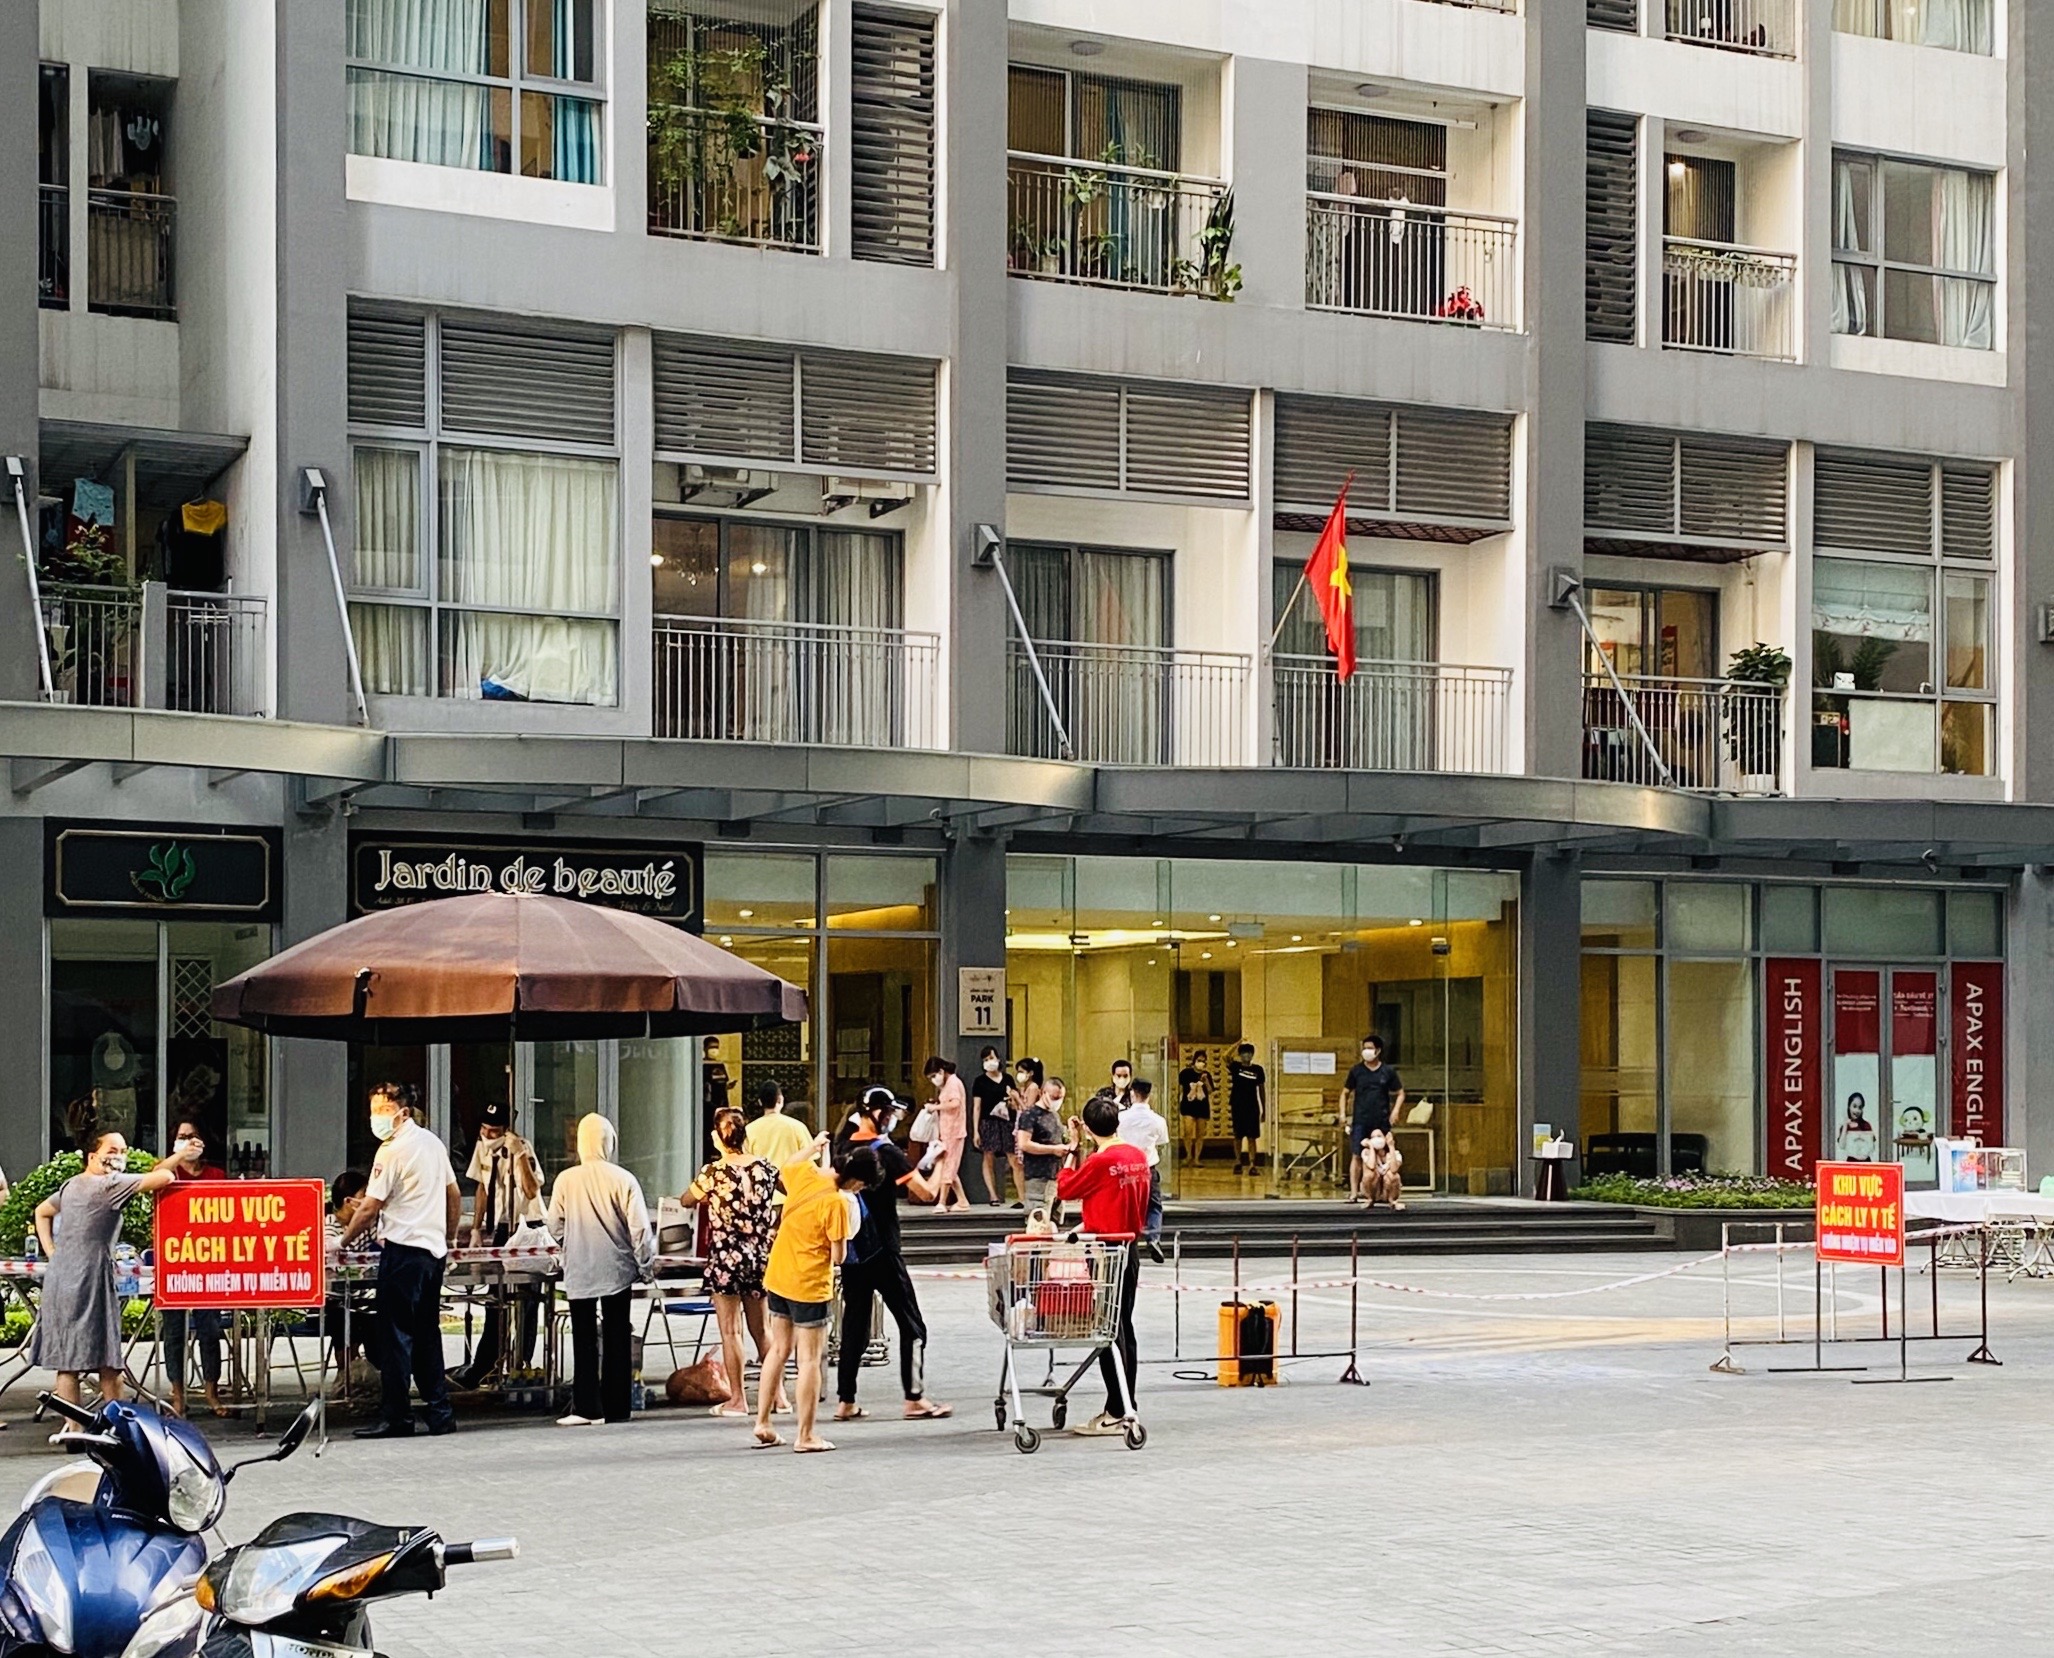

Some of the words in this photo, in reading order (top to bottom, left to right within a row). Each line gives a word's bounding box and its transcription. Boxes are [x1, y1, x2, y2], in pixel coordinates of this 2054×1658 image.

[375, 850, 493, 891] Jardin
[500, 855, 547, 893] de
[553, 857, 677, 899] beauté
[971, 994, 994, 1003] PARK
[975, 1006, 991, 1026] 11
[1966, 982, 1983, 1051] APAX
[1784, 978, 1802, 1092] ENGLISH
[1966, 1059, 1983, 1149] ENGLI
[1784, 1100, 1802, 1171] APAX
[1833, 1175, 1857, 1196] KHU
[1858, 1174, 1883, 1202] VỰC
[189, 1197, 235, 1223] KHU
[241, 1194, 286, 1228] VỰC
[1821, 1201, 1853, 1227] CÁCH
[1855, 1206, 1868, 1228] LY
[1870, 1207, 1879, 1229] Y
[1881, 1202, 1897, 1230] TẾ
[165, 1231, 226, 1263] CÁCH
[233, 1236, 257, 1262] LY
[263, 1235, 278, 1262] Y
[283, 1227, 312, 1262] TẾ
[166, 1270, 204, 1293] KHÔNG
[206, 1269, 241, 1297] NHIỆM
[243, 1273, 258, 1296] VỤ
[290, 1268, 312, 1292] VÀO
